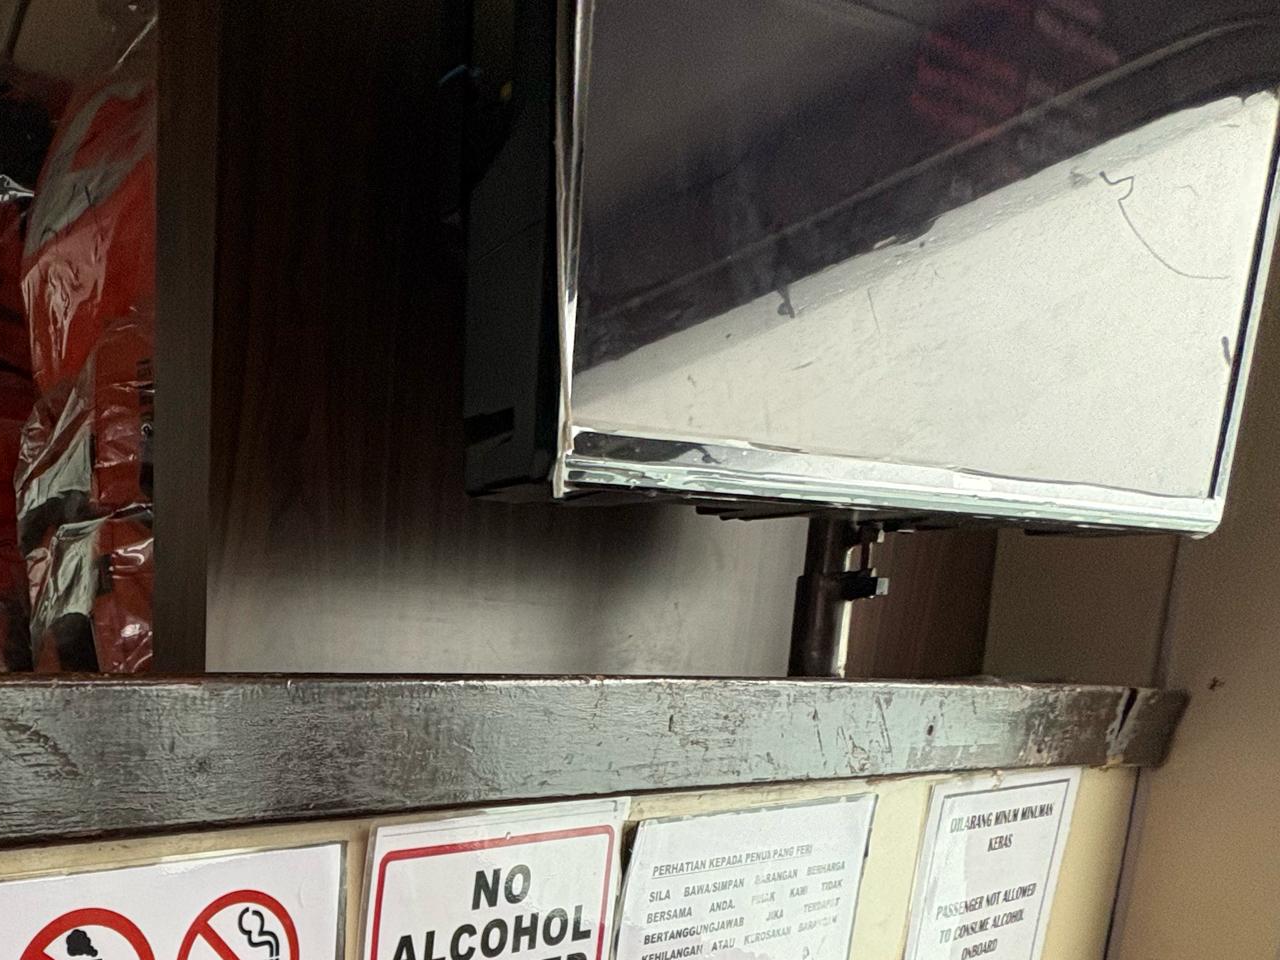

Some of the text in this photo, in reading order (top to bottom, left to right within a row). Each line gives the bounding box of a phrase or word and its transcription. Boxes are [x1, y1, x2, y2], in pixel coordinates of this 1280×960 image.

[950, 813, 992, 833] DILARANG
[652, 859, 706, 876] PERHATIAN
[708, 855, 742, 869] KEPADA
[472, 864, 532, 911] NO
[649, 878, 744, 903] SILA BAWA/SIMPAN
[936, 883, 1037, 920] PASSENGER NOT ALLOWED
[646, 907, 692, 924] BERSAMA
[643, 917, 744, 945] BERTANGGUNGJAWAB
[939, 929, 951, 944] TO
[711, 938, 735, 951] ATAU
